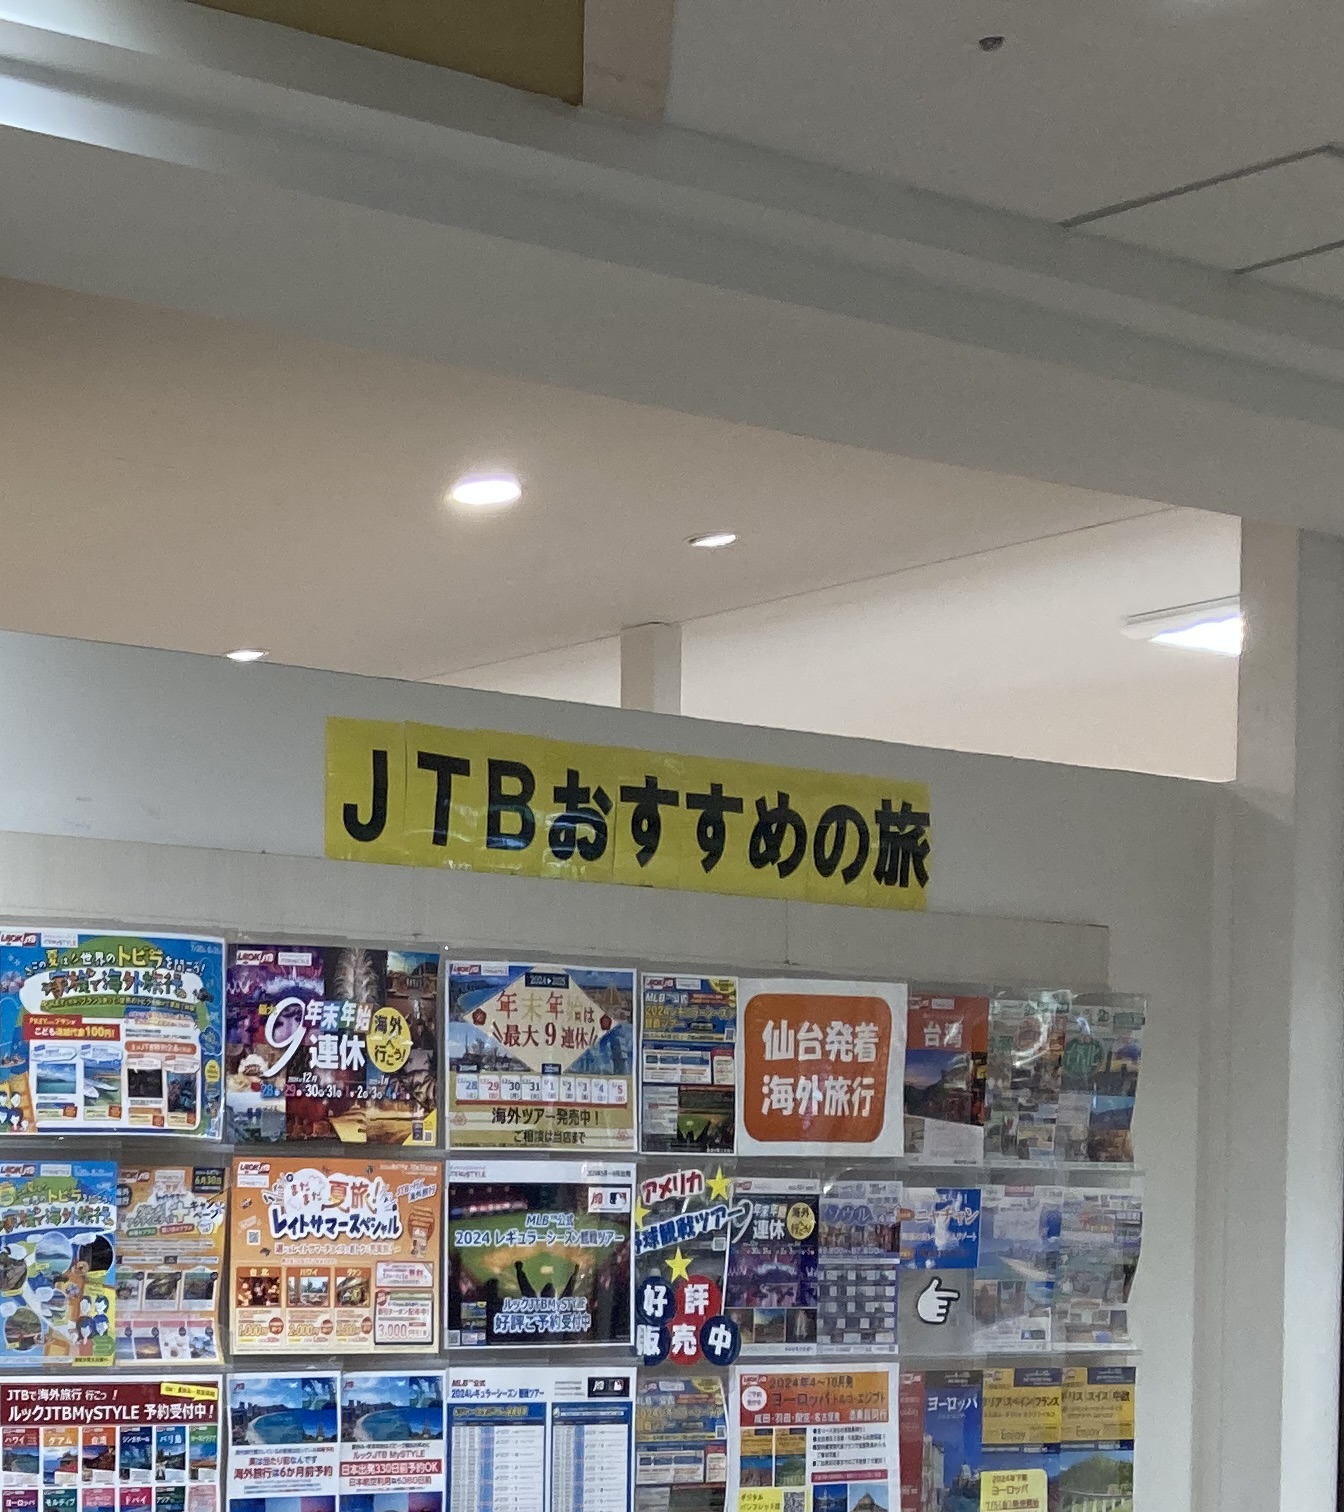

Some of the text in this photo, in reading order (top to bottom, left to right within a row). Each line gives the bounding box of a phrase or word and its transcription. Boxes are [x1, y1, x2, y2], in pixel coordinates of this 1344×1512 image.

[343, 750, 931, 887] JTBおすすめの旅
[305, 1000, 373, 1033] 年末年始
[309, 1035, 366, 1070] 連休
[762, 1020, 880, 1063] 仙台発着
[762, 1075, 875, 1117] 海外旅行
[642, 1171, 704, 1204] アメリカ
[272, 1208, 400, 1236] レイトサマースペシャル
[927, 1394, 978, 1411] ヨーロッパ
